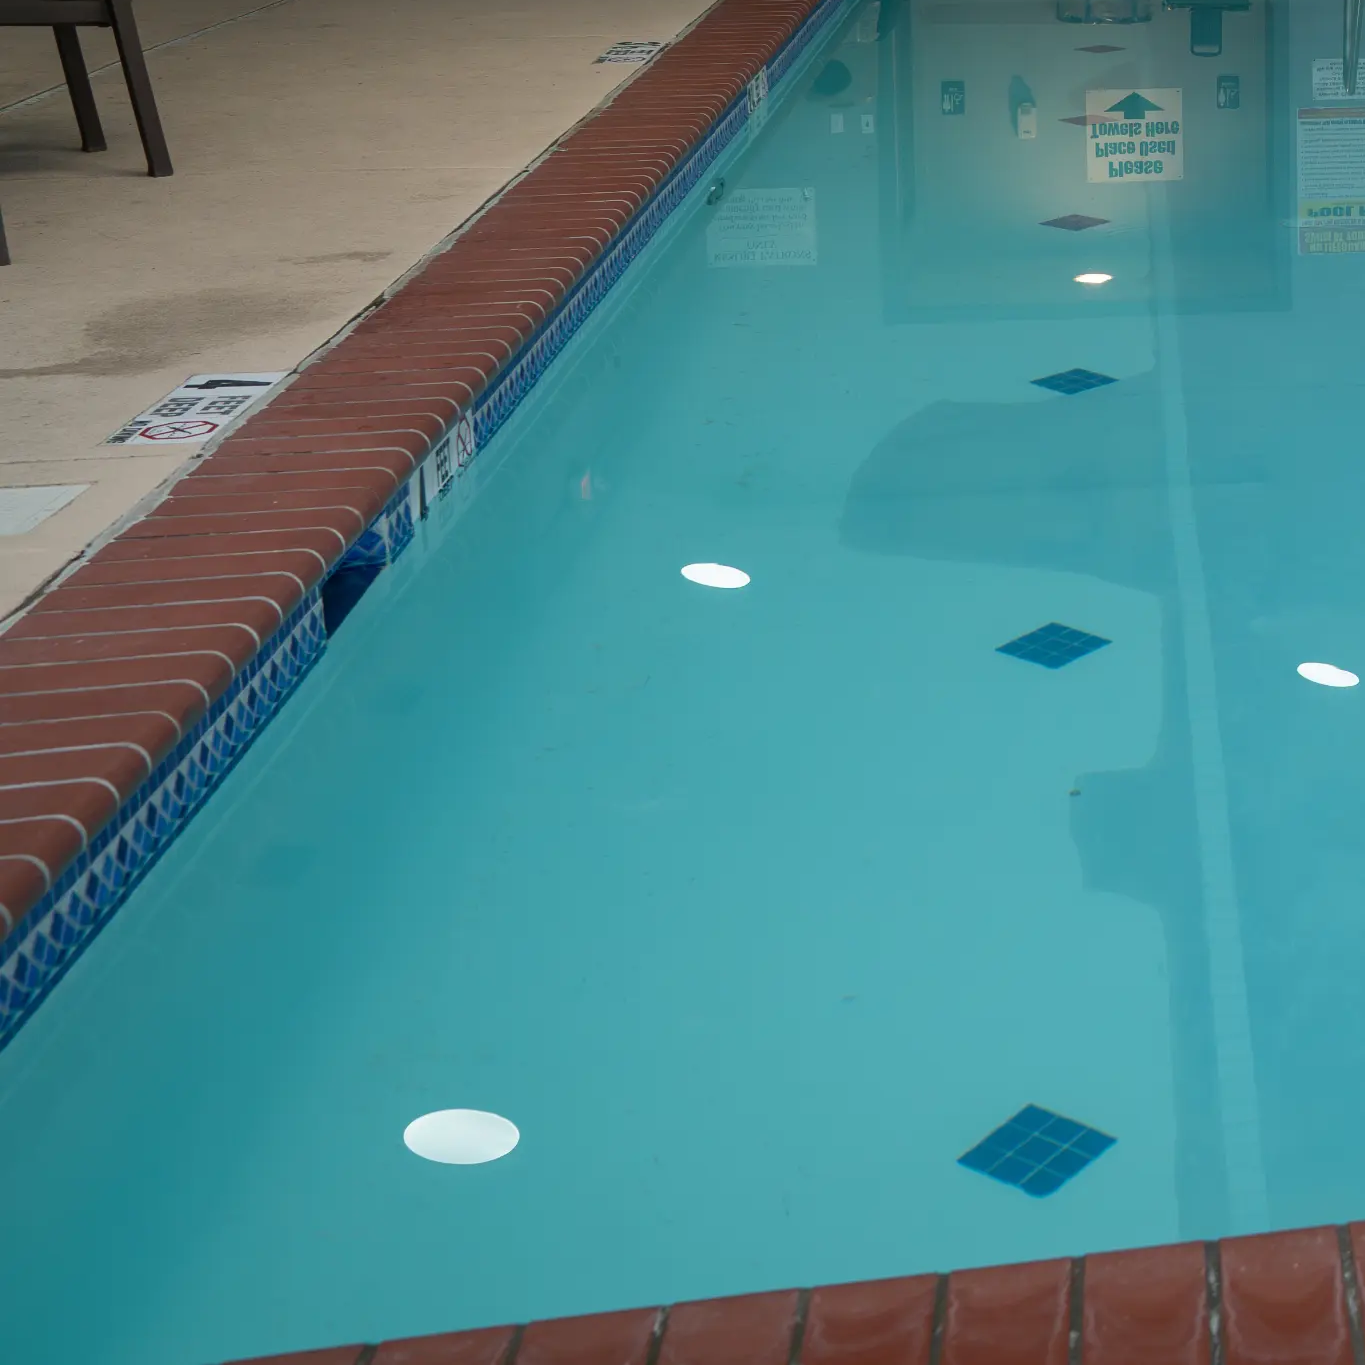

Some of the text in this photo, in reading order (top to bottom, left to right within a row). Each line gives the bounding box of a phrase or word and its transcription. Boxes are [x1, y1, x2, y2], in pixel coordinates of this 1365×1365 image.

[183, 379, 273, 390] 4
[149, 396, 206, 418] DEEP
[195, 395, 252, 416] FEET
